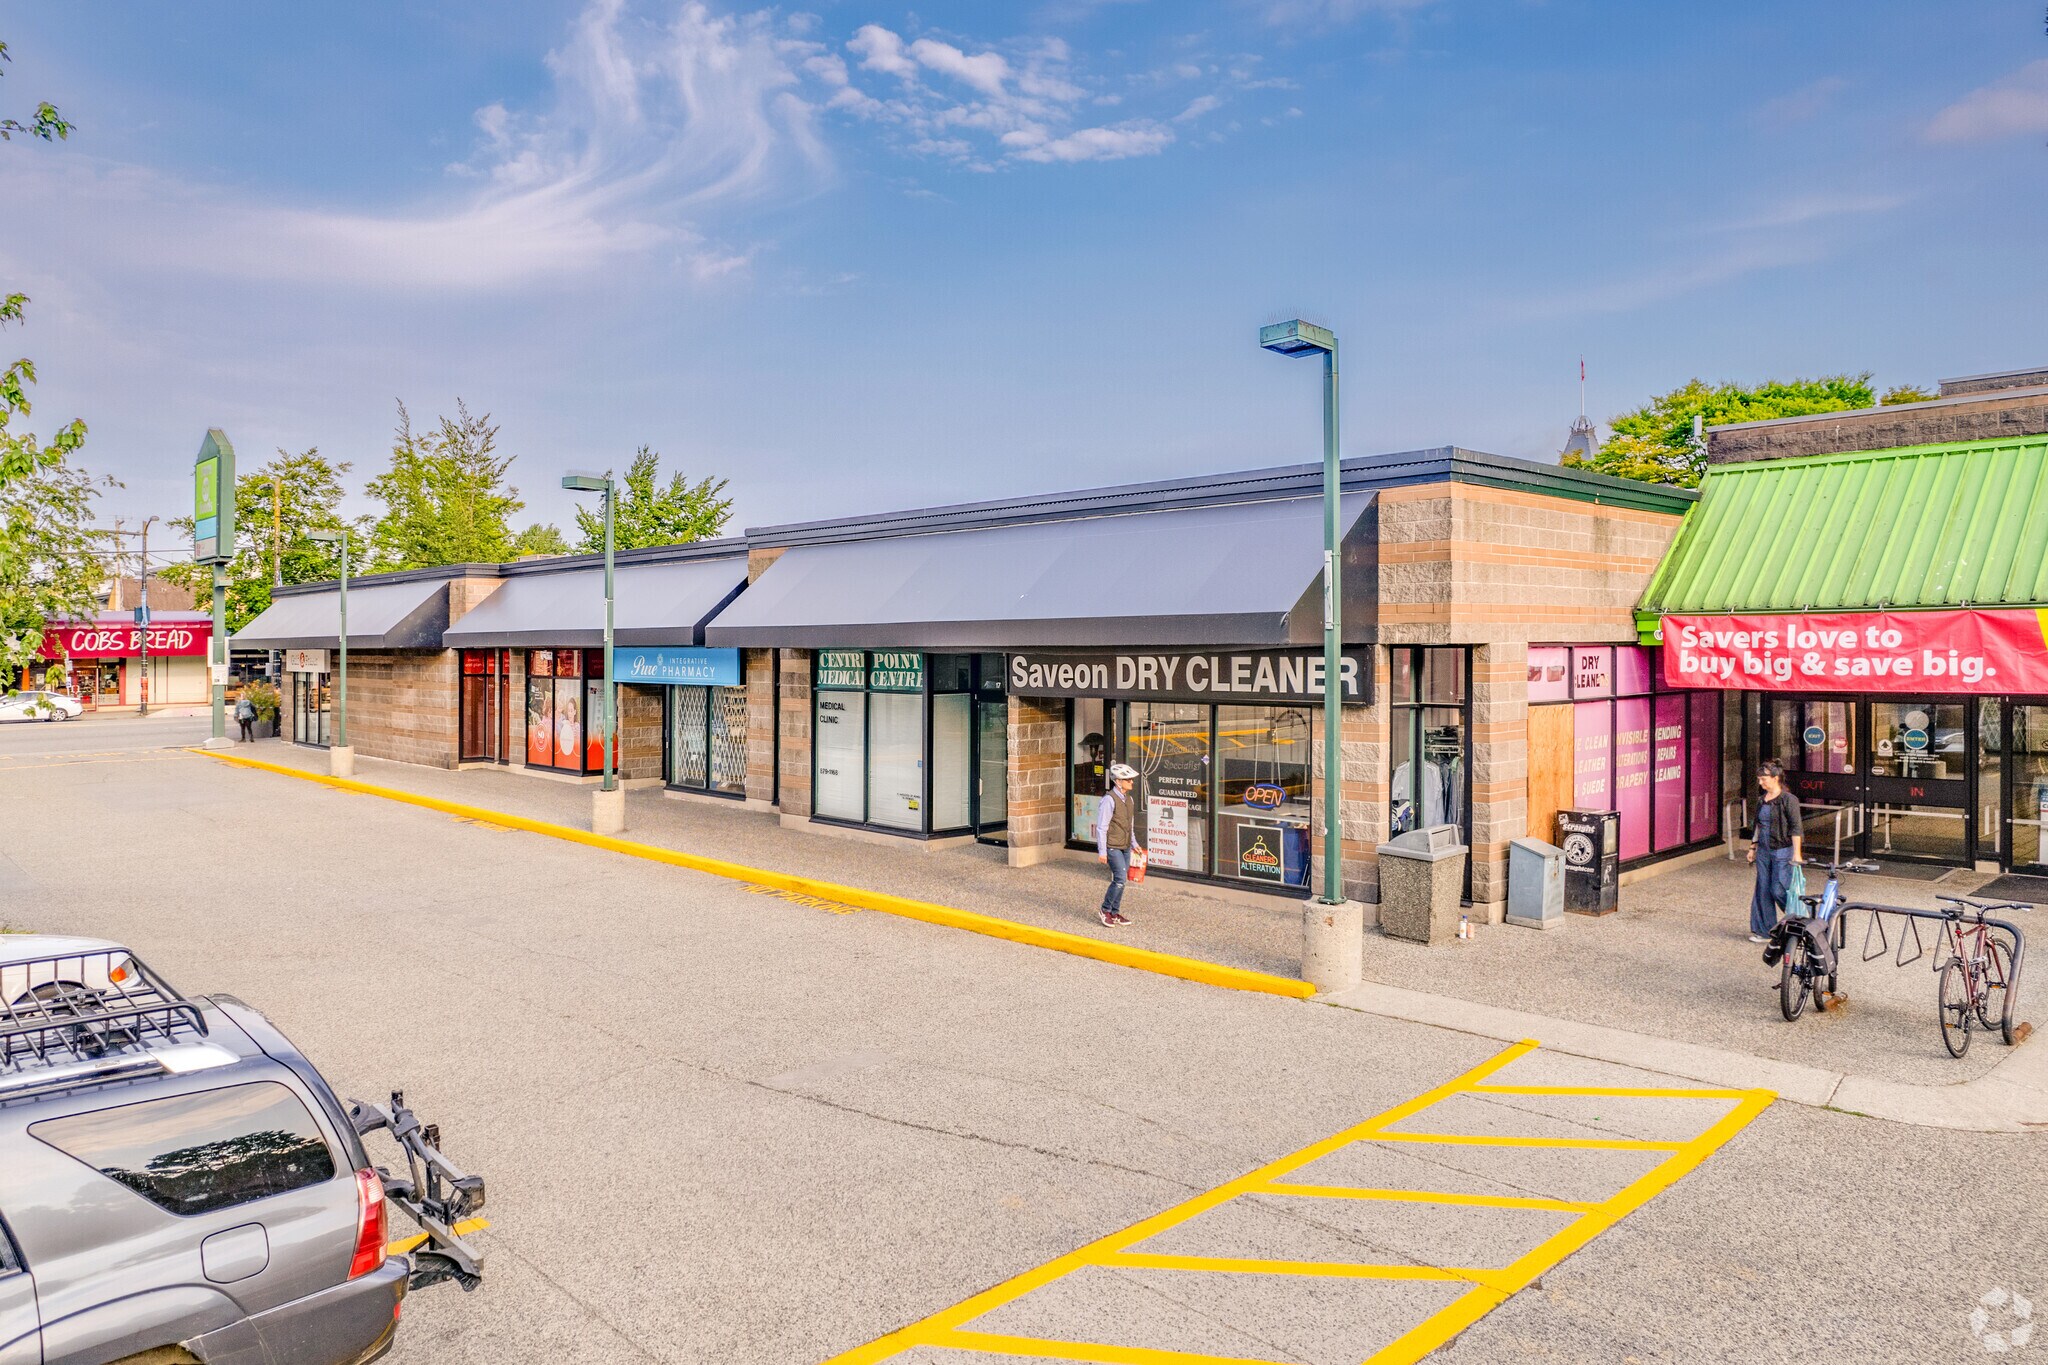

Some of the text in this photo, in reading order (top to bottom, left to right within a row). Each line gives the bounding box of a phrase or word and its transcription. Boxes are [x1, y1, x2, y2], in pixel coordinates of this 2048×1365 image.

[72, 629, 193, 651] COBS BREAD
[1681, 624, 1902, 649] Savers love to
[630, 655, 716, 678] Pure PHARMACY
[872, 652, 920, 669] POINT
[1582, 656, 1600, 670] DRY
[1680, 650, 1996, 683] buy big & save big.
[1012, 655, 1358, 694] Saveon DRY CLEANER
[820, 701, 846, 710] MEDICAL
[820, 715, 838, 724] CLINIC
[1584, 734, 1608, 750] CLEAN
[1656, 746, 1677, 762] REPAIRS
[1158, 776, 1184, 784] PERFECT
[1655, 765, 1681, 782] LEANING
[1582, 778, 1606, 796] SUEDE
[1800, 780, 1825, 790] OUT
[1910, 786, 1924, 796] IN
[1158, 788, 1198, 798] GUARANTEED
[1245, 786, 1283, 806] OPEN
[1167, 800, 1186, 808] CLEANERS
[1152, 828, 1186, 837] ALTERATIONS
[1152, 838, 1178, 846] HEMMING
[1152, 848, 1175, 856] ZIPPERS
[1244, 854, 1276, 864] CLEANERS
